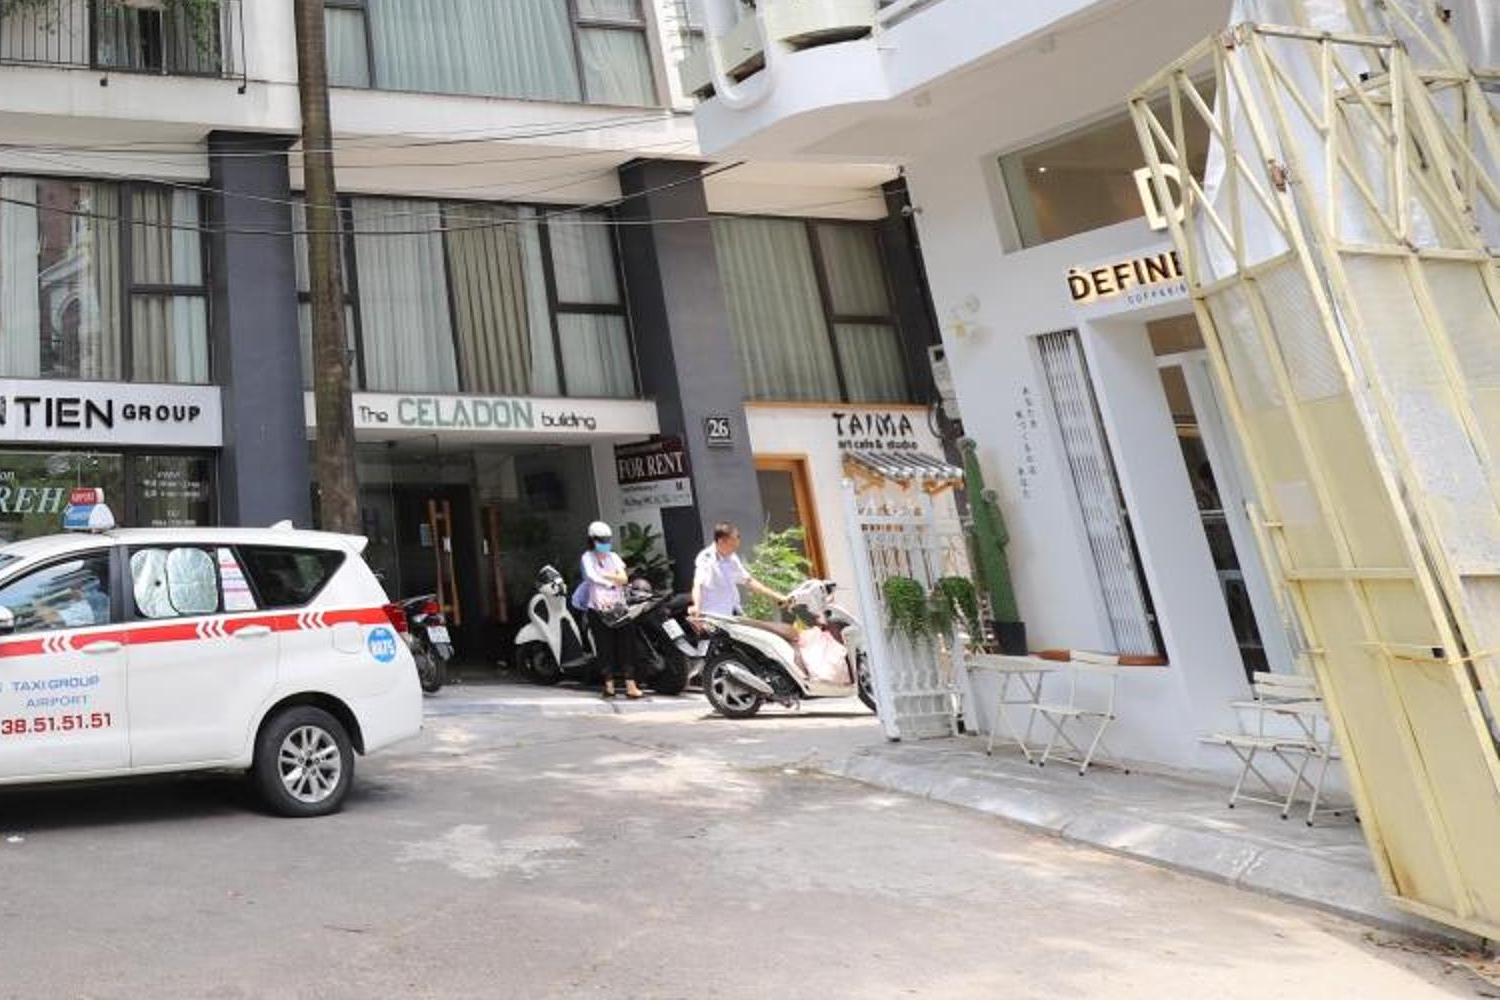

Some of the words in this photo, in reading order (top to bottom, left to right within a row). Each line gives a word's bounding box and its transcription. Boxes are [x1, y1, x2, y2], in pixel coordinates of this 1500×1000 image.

[121, 403, 201, 423] GROUP
[358, 405, 389, 423] The
[398, 398, 535, 428] CELADON
[541, 411, 597, 431] building
[709, 419, 729, 437] 26
[832, 412, 914, 437] TAIMA
[838, 439, 853, 449] art
[887, 439, 918, 450] studio
[618, 456, 645, 479] FOR
[646, 451, 684, 477] RENT
[12, 679, 45, 692] TAXI
[47, 674, 100, 690] GROUP
[26, 694, 88, 709] AIRPORT
[1, 712, 113, 736] 38.51.51.51
